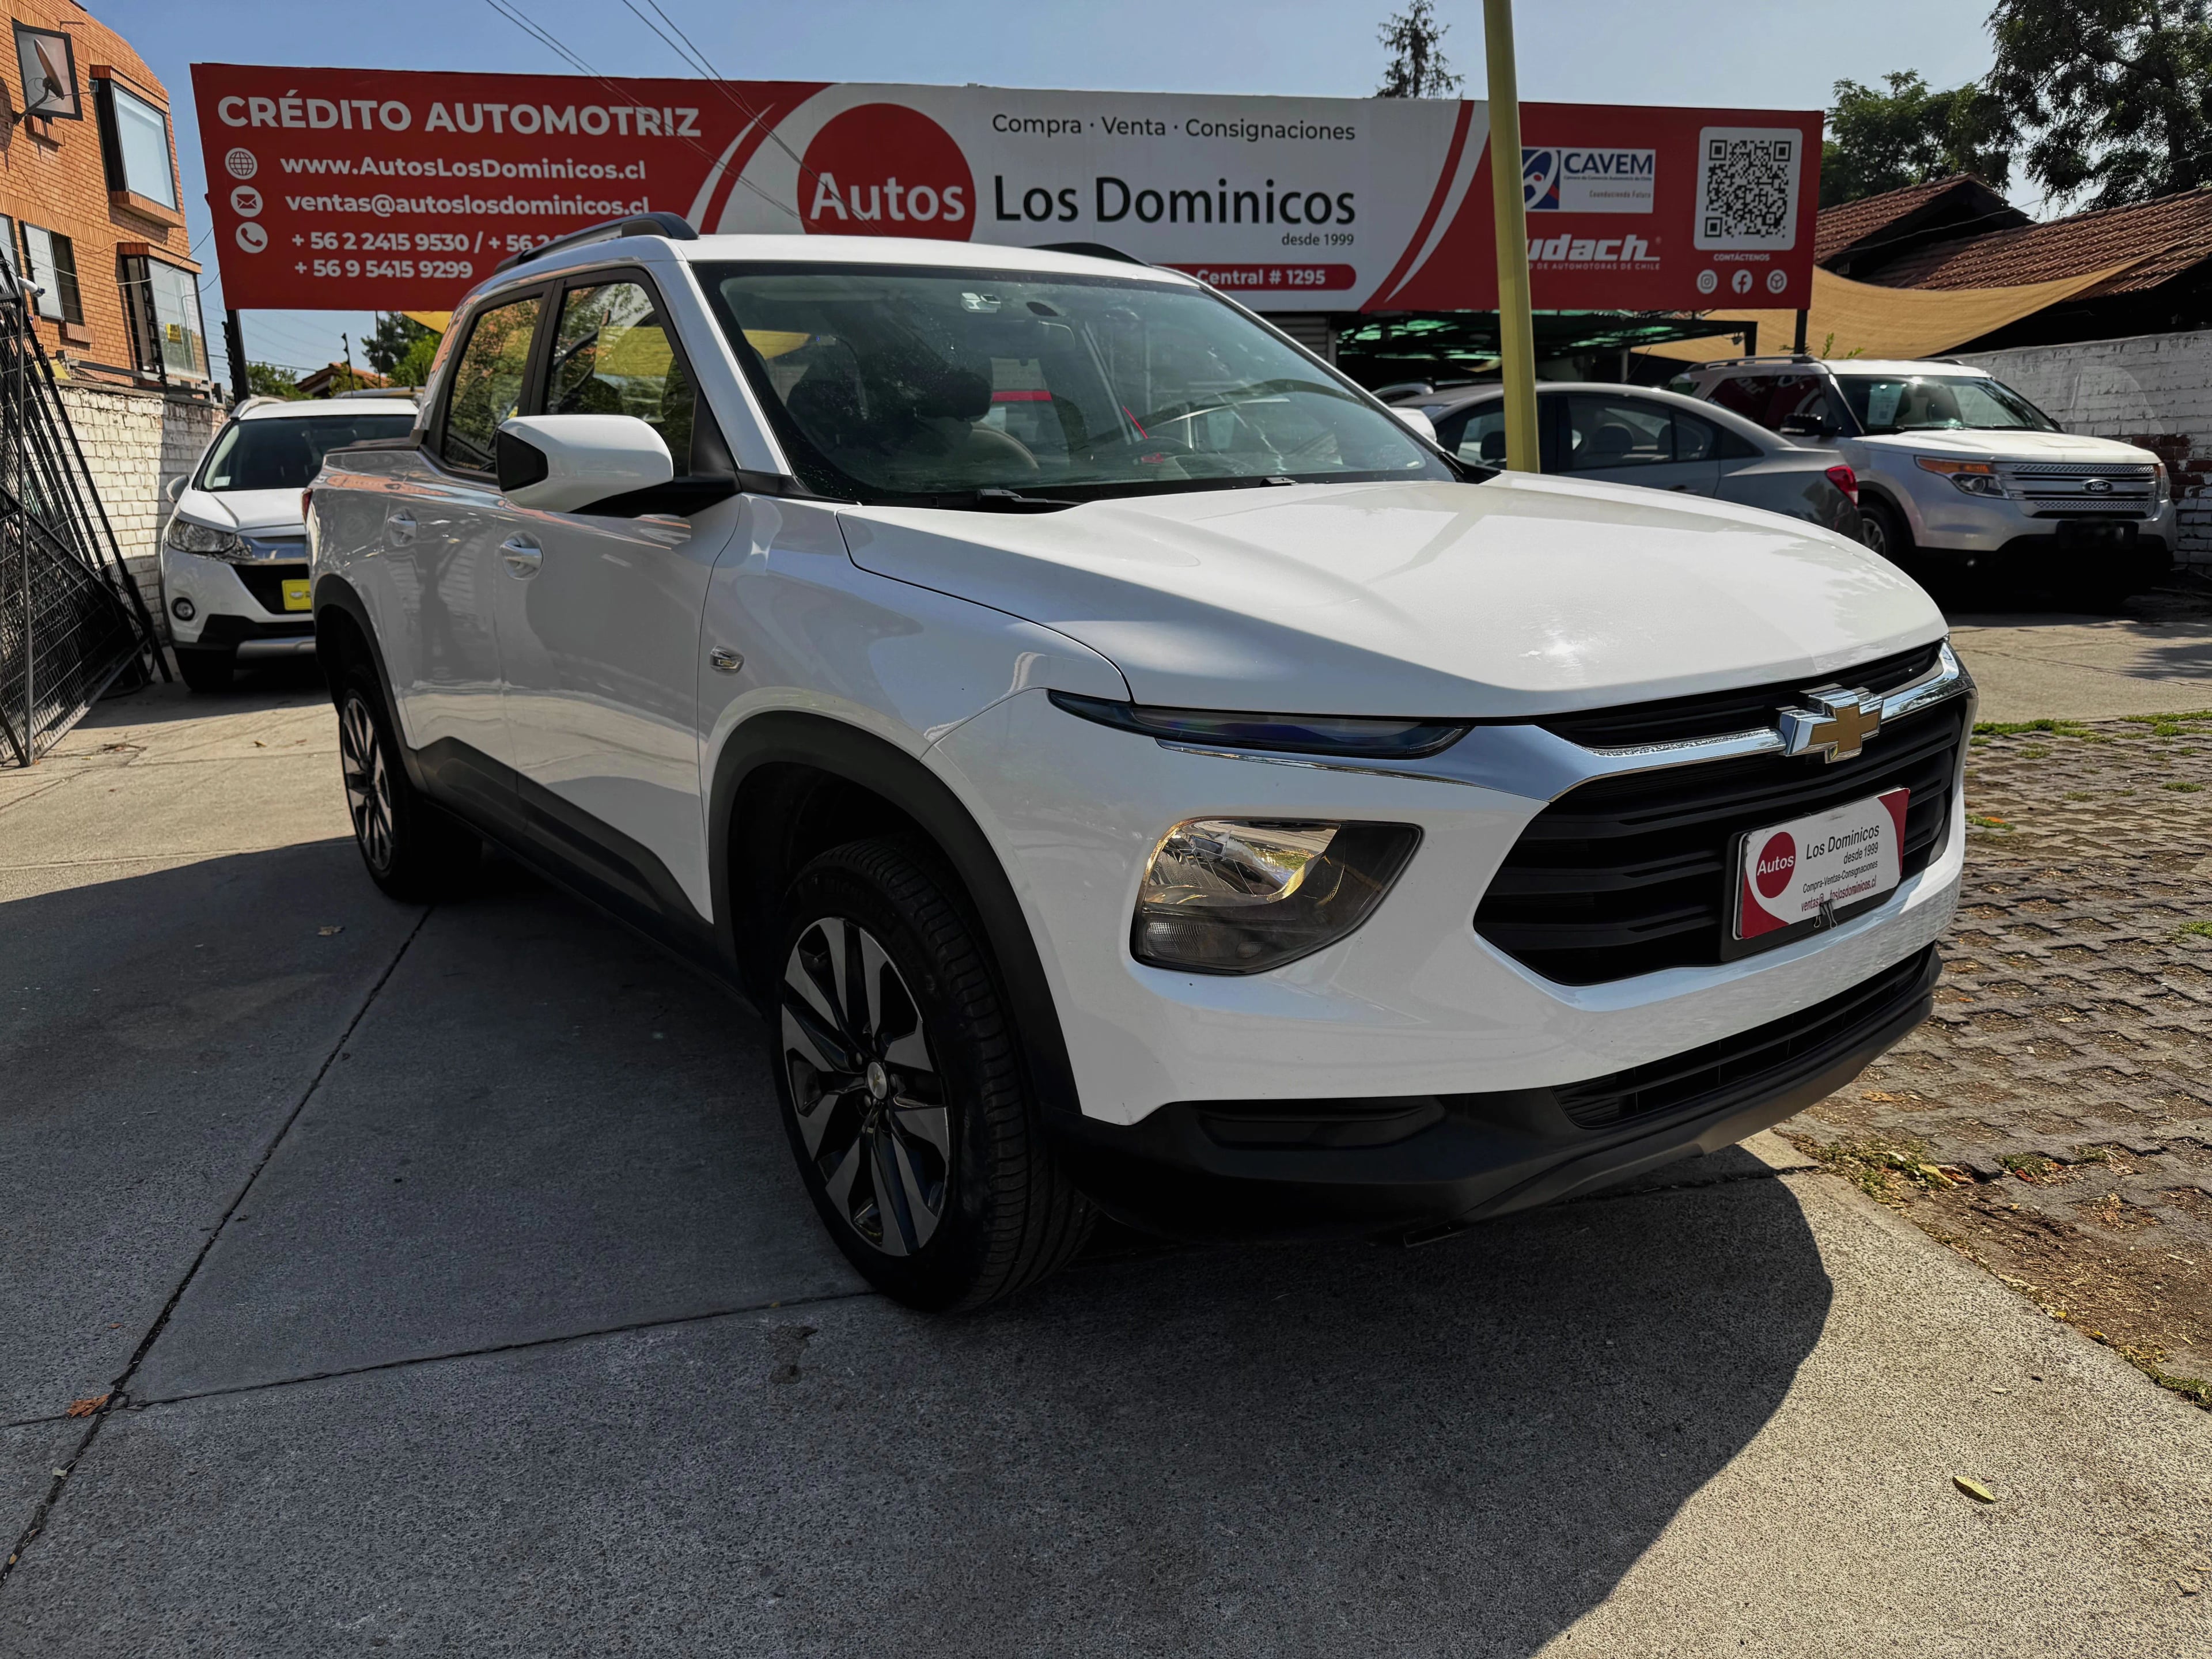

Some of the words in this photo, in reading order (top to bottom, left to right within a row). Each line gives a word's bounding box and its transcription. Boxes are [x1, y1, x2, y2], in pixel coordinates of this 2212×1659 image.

[218, 89, 412, 131] CRÉDITO
[425, 102, 701, 137] AUTOMOTRIZ
[993, 113, 1081, 138] Compra
[1101, 116, 1165, 136] Venta
[1185, 118, 1356, 142] Consignaciones
[281, 156, 646, 180] www.AutosLosDominicos.cl
[1564, 153, 1653, 175] CAVEM
[285, 193, 649, 217] ventas@autoslosdominicos.cl
[810, 173, 965, 222] Autos
[995, 175, 1078, 222] Los
[1096, 177, 1355, 225] Dominicos
[310, 232, 339, 250] 56
[342, 232, 357, 250] 2
[361, 232, 411, 251] 2415
[415, 233, 469, 252] 9530
[506, 234, 533, 252] 56
[1281, 232, 1320, 246] desde
[1324, 233, 1354, 246] 1999
[1527, 233, 1660, 261] udach
[1537, 262, 1548, 270] DE
[1551, 262, 1617, 270] AUTOMOTORAS
[1620, 262, 1631, 270] DE
[1713, 252, 1770, 262] CONTÁCTENOS
[313, 259, 342, 277] 56
[345, 260, 361, 277] 9
[366, 260, 415, 278] 5415
[419, 260, 473, 279] 9299
[1197, 270, 1263, 285] Central
[1269, 270, 1282, 285] #
[1286, 270, 1325, 285] 1295
[1806, 843, 1825, 860] Los
[1827, 825, 1880, 853] Dominicos
[1843, 848, 1862, 864] desde
[1864, 842, 1878, 857] 1999
[1757, 855, 1794, 876] Autos
